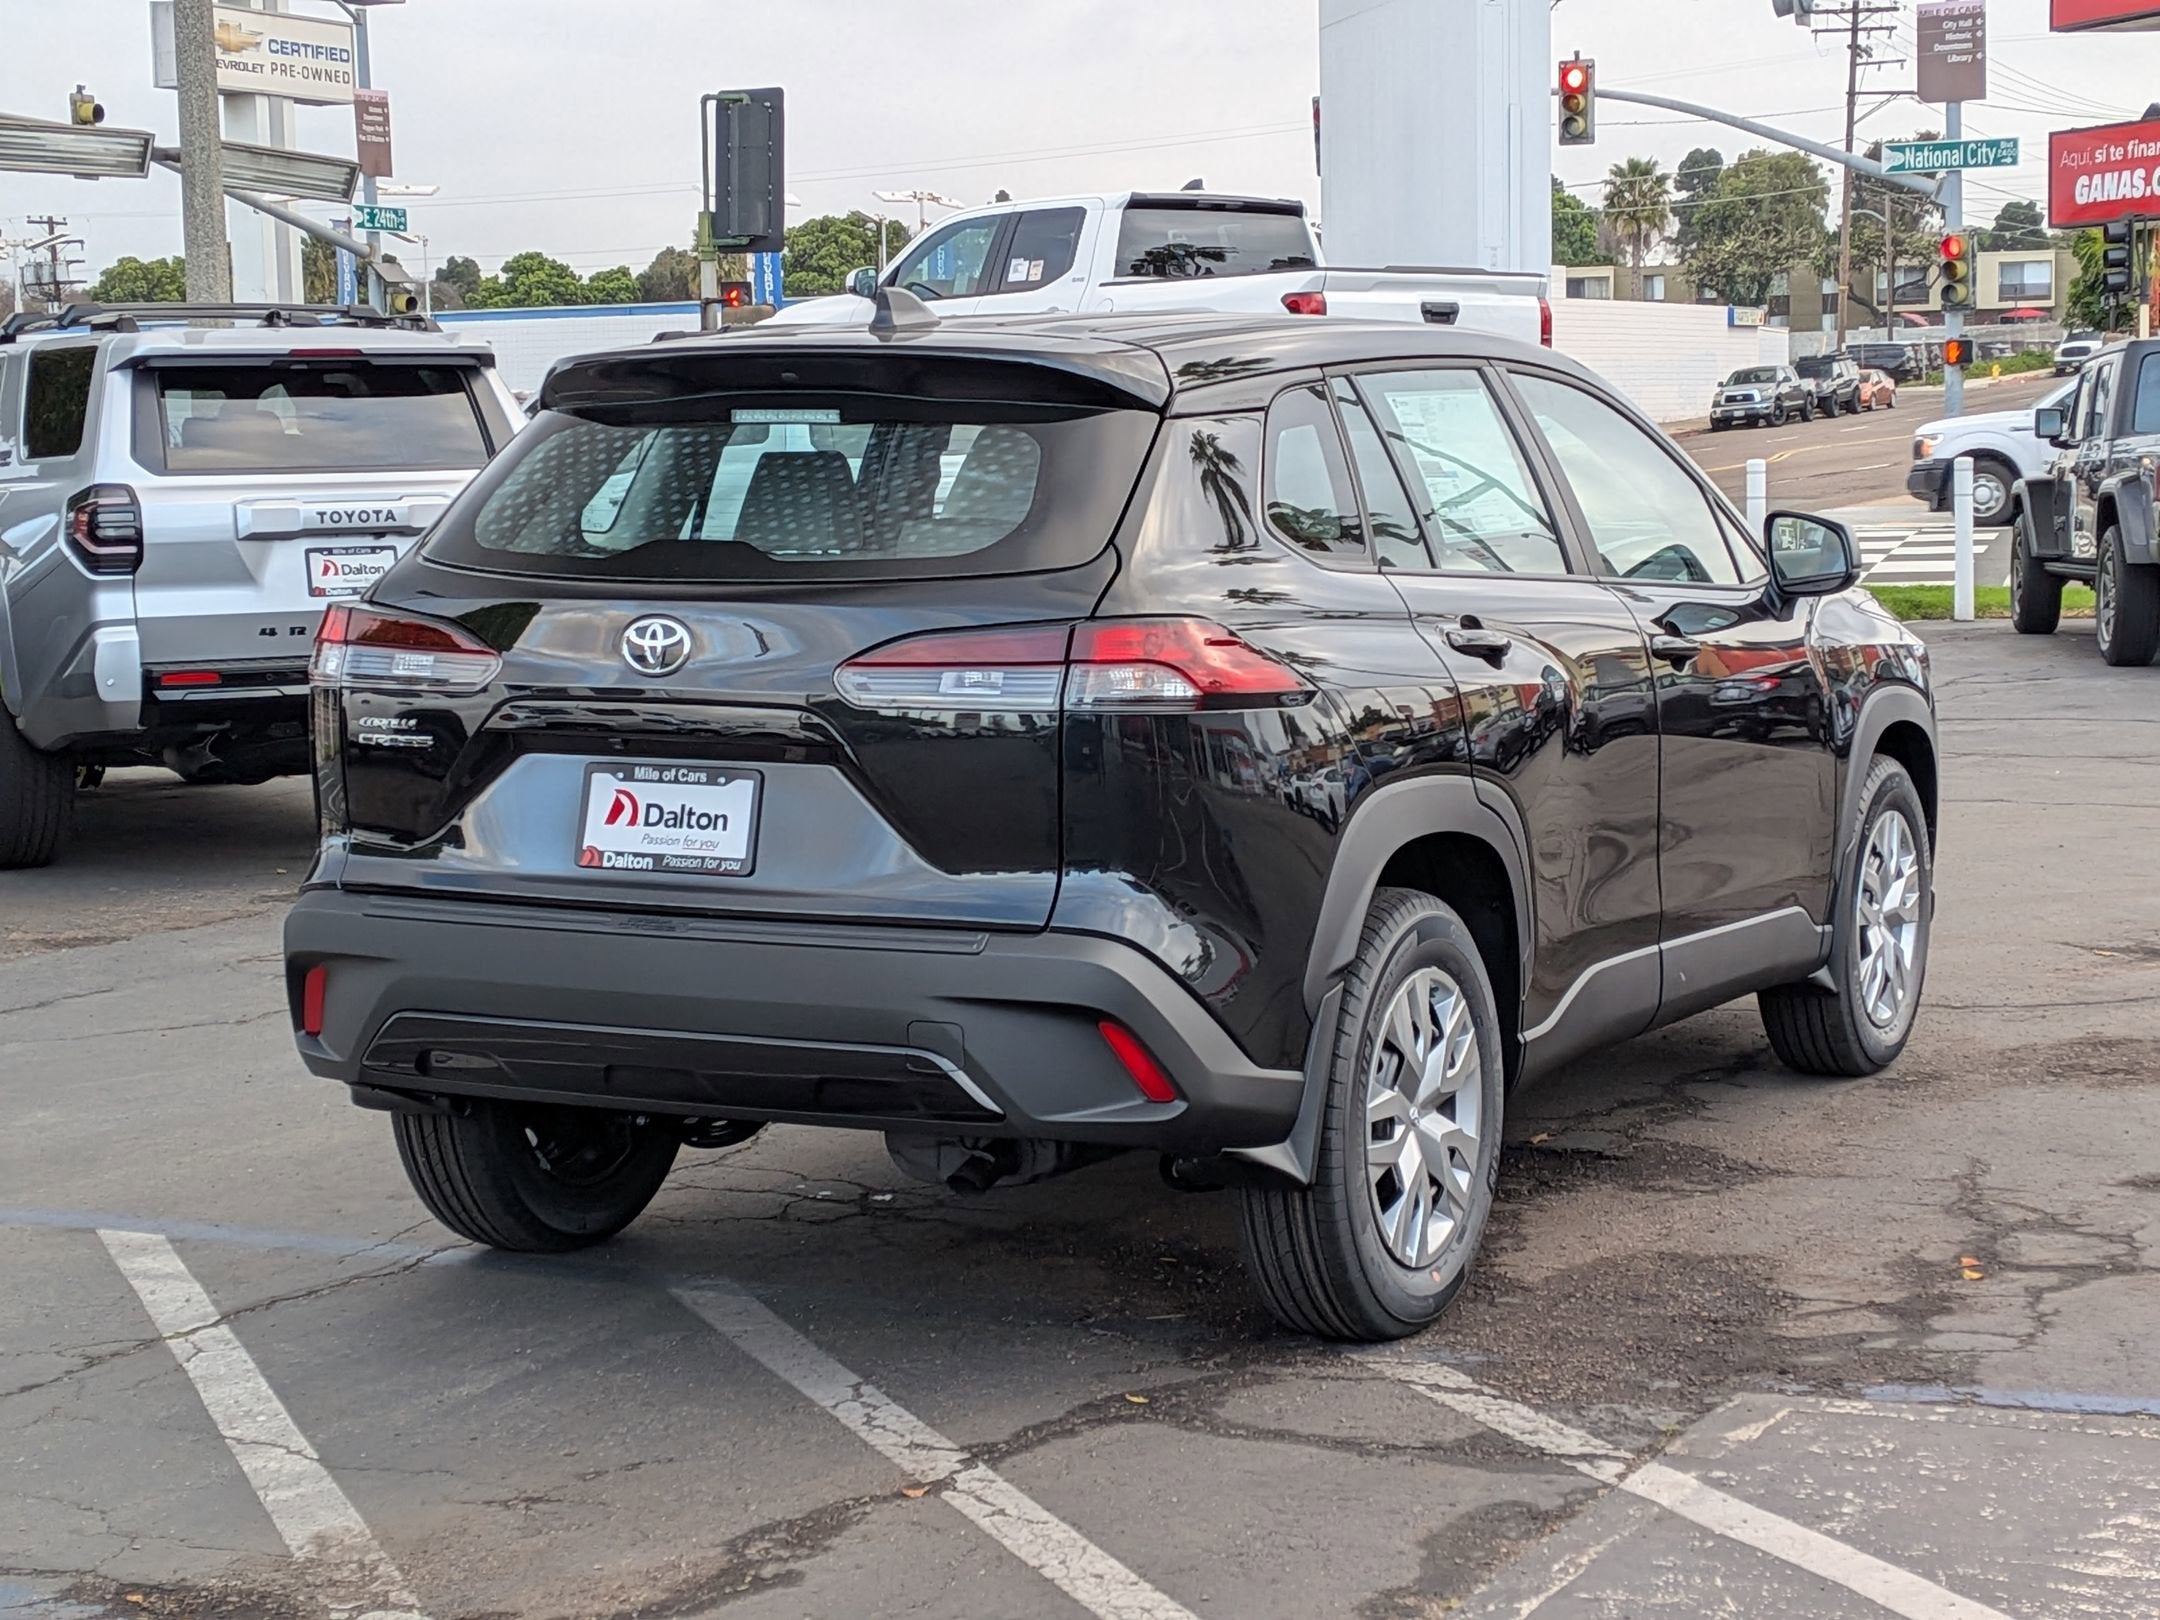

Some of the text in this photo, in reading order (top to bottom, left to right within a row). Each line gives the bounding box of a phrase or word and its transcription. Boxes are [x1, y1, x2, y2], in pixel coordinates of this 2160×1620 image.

[1918, 5, 1984, 17] MILE OF CARS
[268, 38, 350, 63] CERTIFIED
[216, 59, 351, 84] EVROLET PRE-OWNED
[1905, 143, 1997, 169] National City
[2060, 147, 2093, 170] Aquí,
[2110, 145, 2124, 162] te
[363, 207, 373, 227] E
[374, 208, 398, 229] 24th
[316, 509, 397, 523] TOYOTA
[341, 563, 385, 576] Dalton
[634, 766, 707, 783] Mile of Cars
[643, 802, 728, 831] Dalton
[641, 833, 720, 849] Passion for you
[602, 851, 741, 872] Dalton Passion for you
